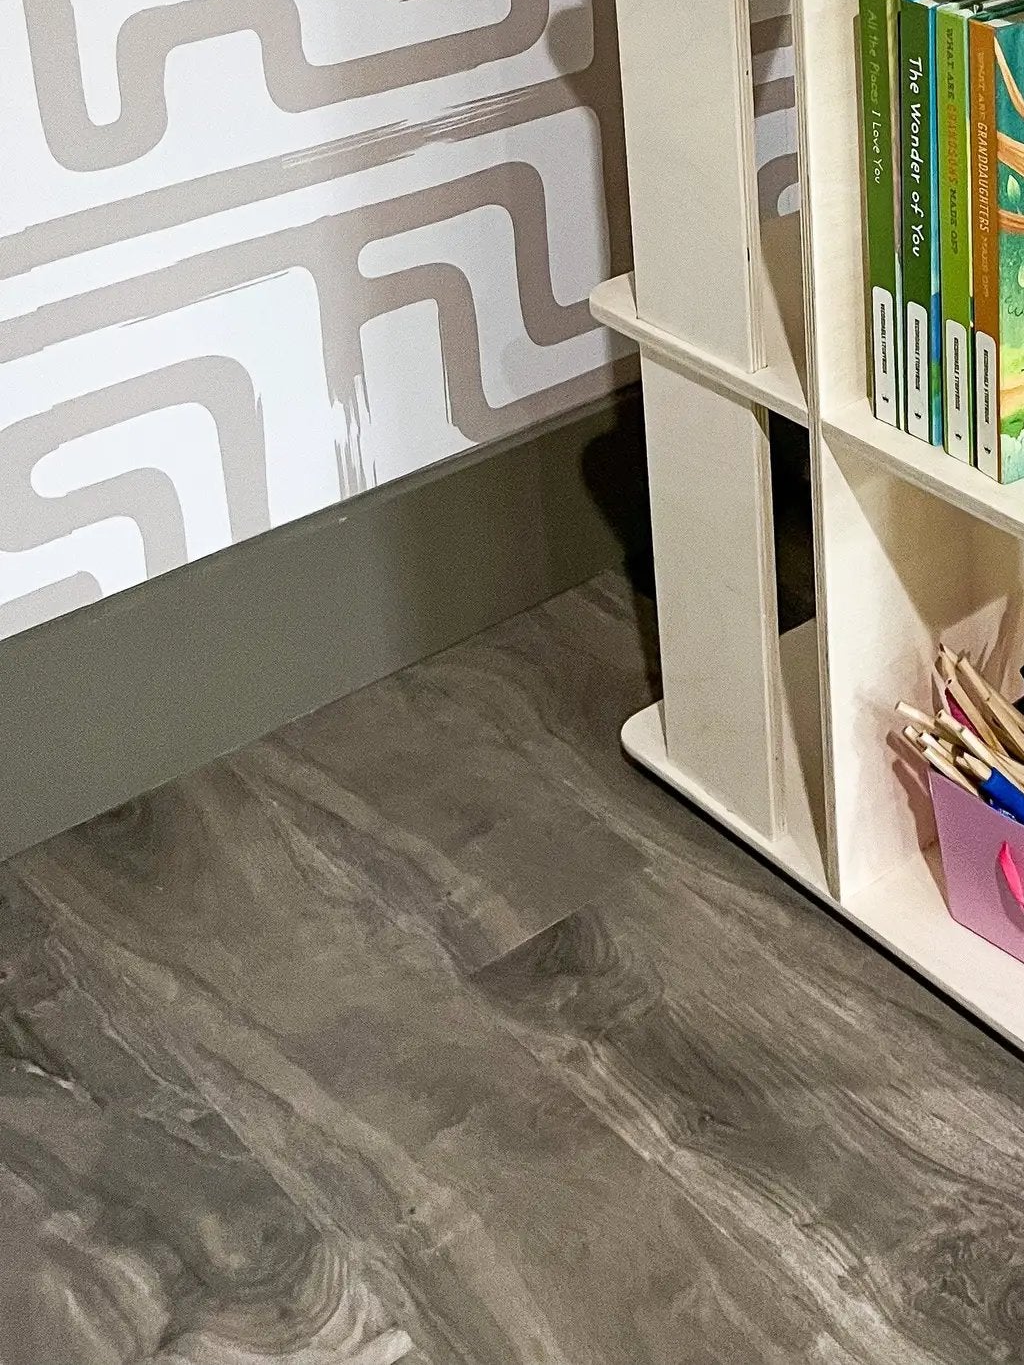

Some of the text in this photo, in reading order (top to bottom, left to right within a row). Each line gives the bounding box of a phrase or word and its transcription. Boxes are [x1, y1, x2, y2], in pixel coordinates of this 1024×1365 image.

[867, 9, 884, 184] All the Places I Love You
[945, 28, 954, 69] WHAT
[908, 57, 924, 257] The Wonder of You
[976, 122, 991, 234] GRANDDAUGHTERS
